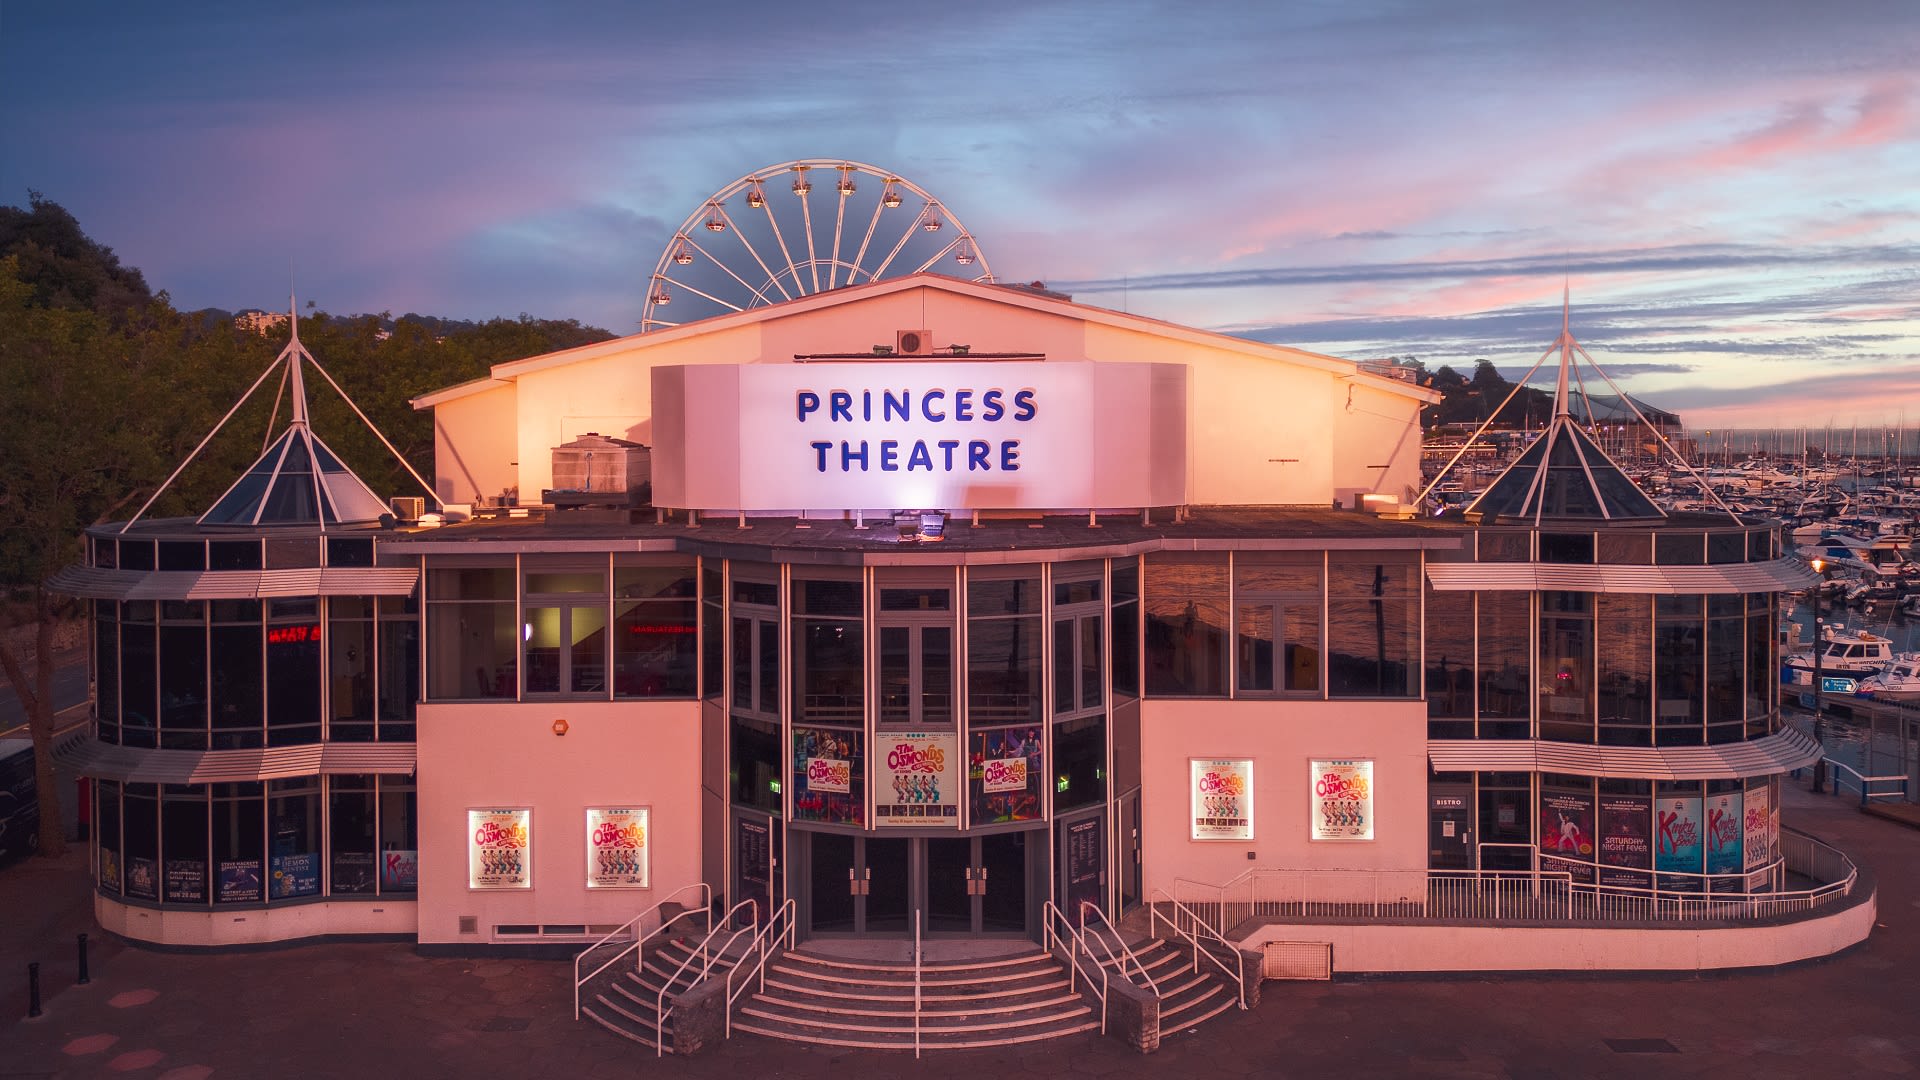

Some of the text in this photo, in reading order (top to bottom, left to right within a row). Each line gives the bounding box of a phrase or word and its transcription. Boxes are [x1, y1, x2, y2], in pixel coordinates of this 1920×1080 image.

[797, 388, 1038, 422] PRINCESS
[811, 439, 1021, 473] THEATRE
[888, 744, 944, 770] OSMONDS
[896, 744, 914, 755] The
[808, 763, 848, 780] OSMONDS
[814, 760, 827, 769] The
[985, 760, 1025, 782] OSMONDS
[991, 761, 1005, 771] The
[1200, 774, 1243, 792] OSMONDS
[1206, 772, 1220, 781] The
[1324, 773, 1340, 783] The
[1316, 774, 1367, 797] OSMONDS
[475, 823, 527, 846] OSMONDS
[483, 822, 499, 832] The
[592, 823, 644, 846] OSMONDS
[600, 822, 617, 832] The
[1605, 837, 1644, 845] SATURDAY
[1543, 863, 1592, 876] NIGHT FEVER
